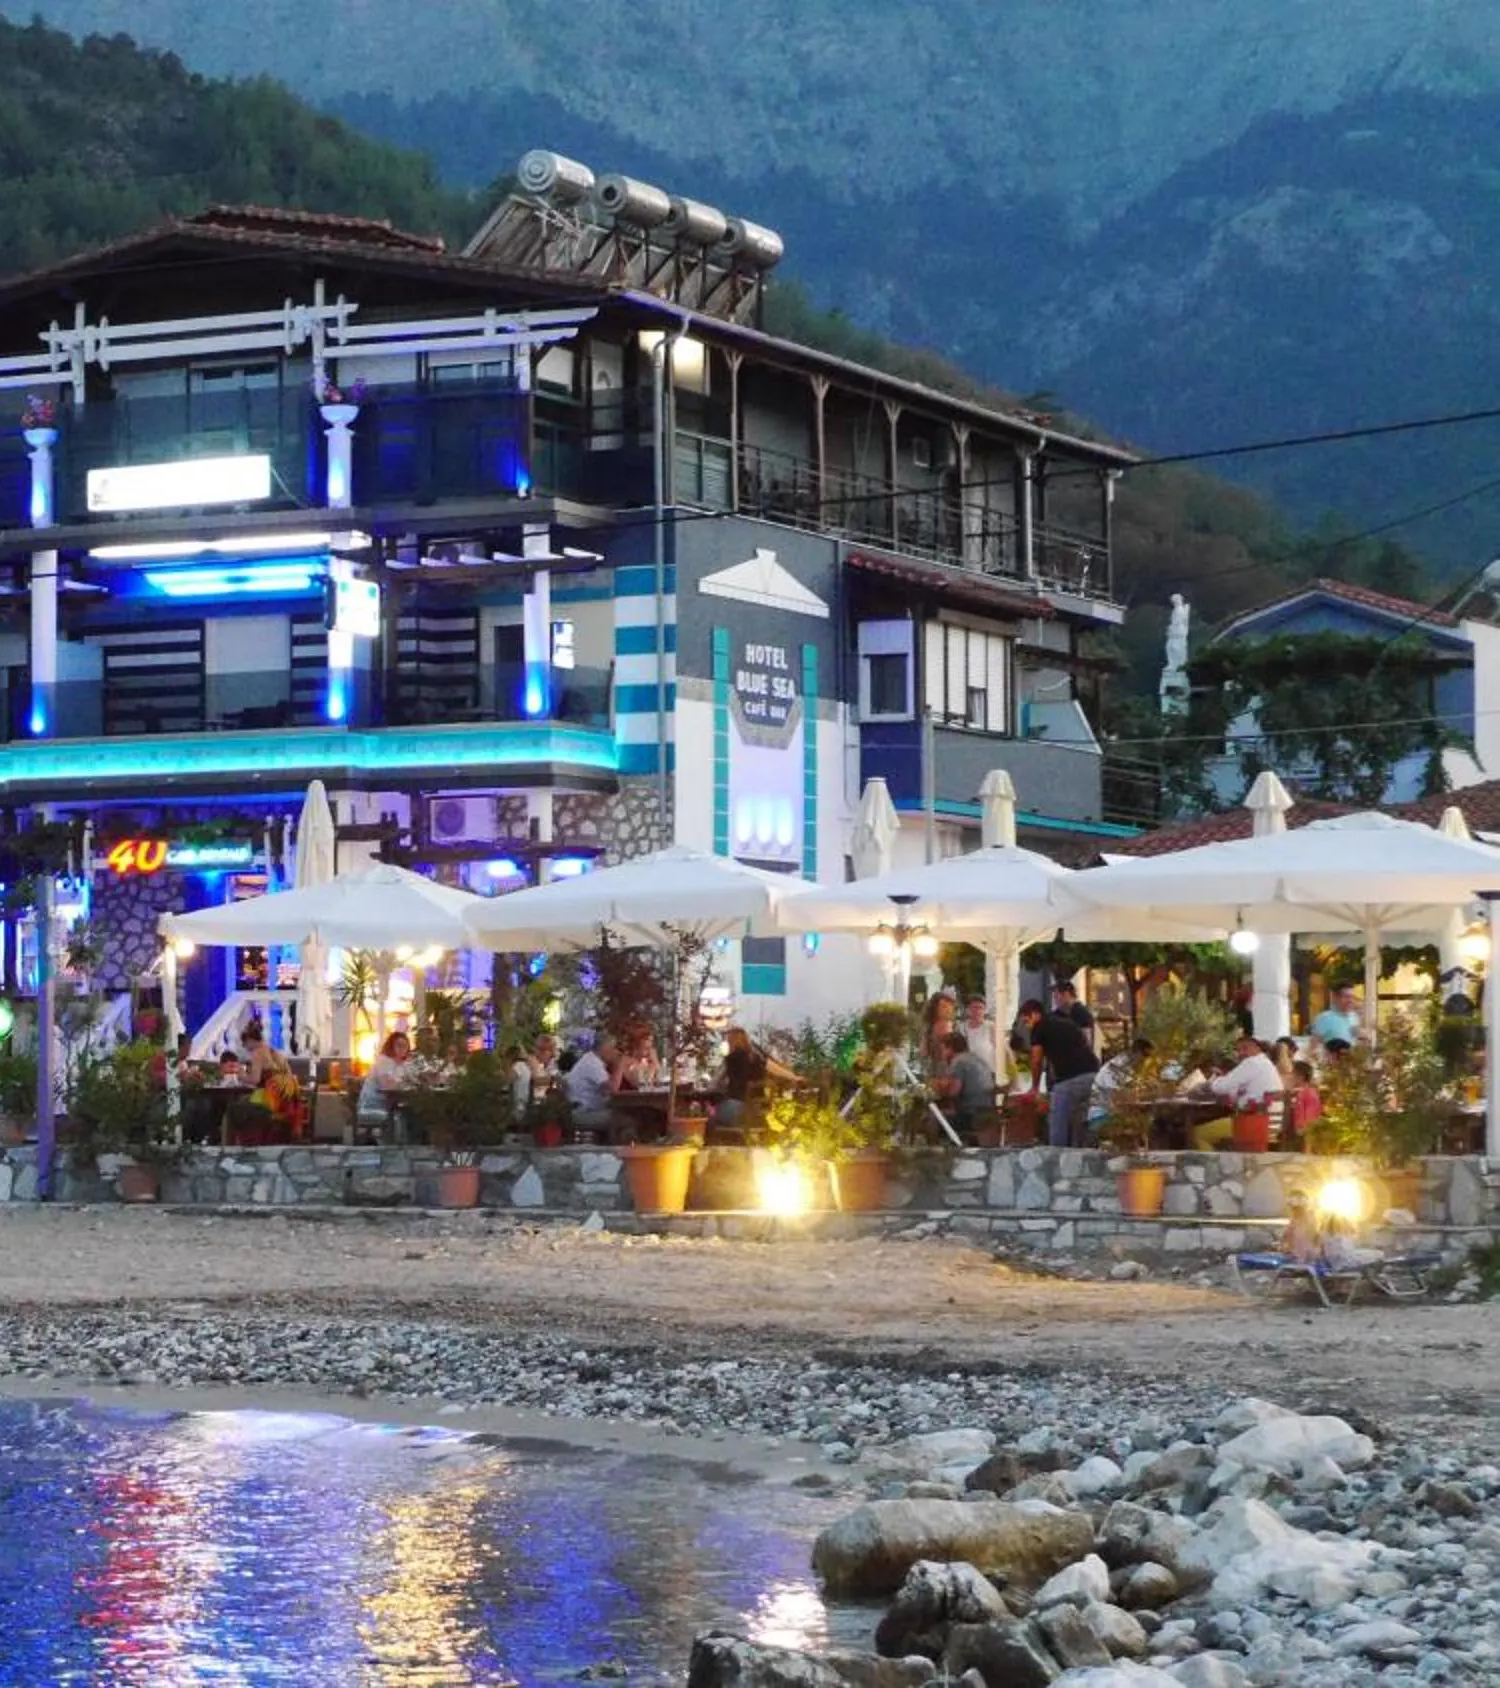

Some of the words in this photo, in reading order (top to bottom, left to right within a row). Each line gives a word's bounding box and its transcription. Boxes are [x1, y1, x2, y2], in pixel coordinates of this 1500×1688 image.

[745, 644, 789, 670] HOTEL
[736, 670, 768, 695] BLUE
[771, 677, 796, 699] SEA
[108, 839, 168, 873] 4U
